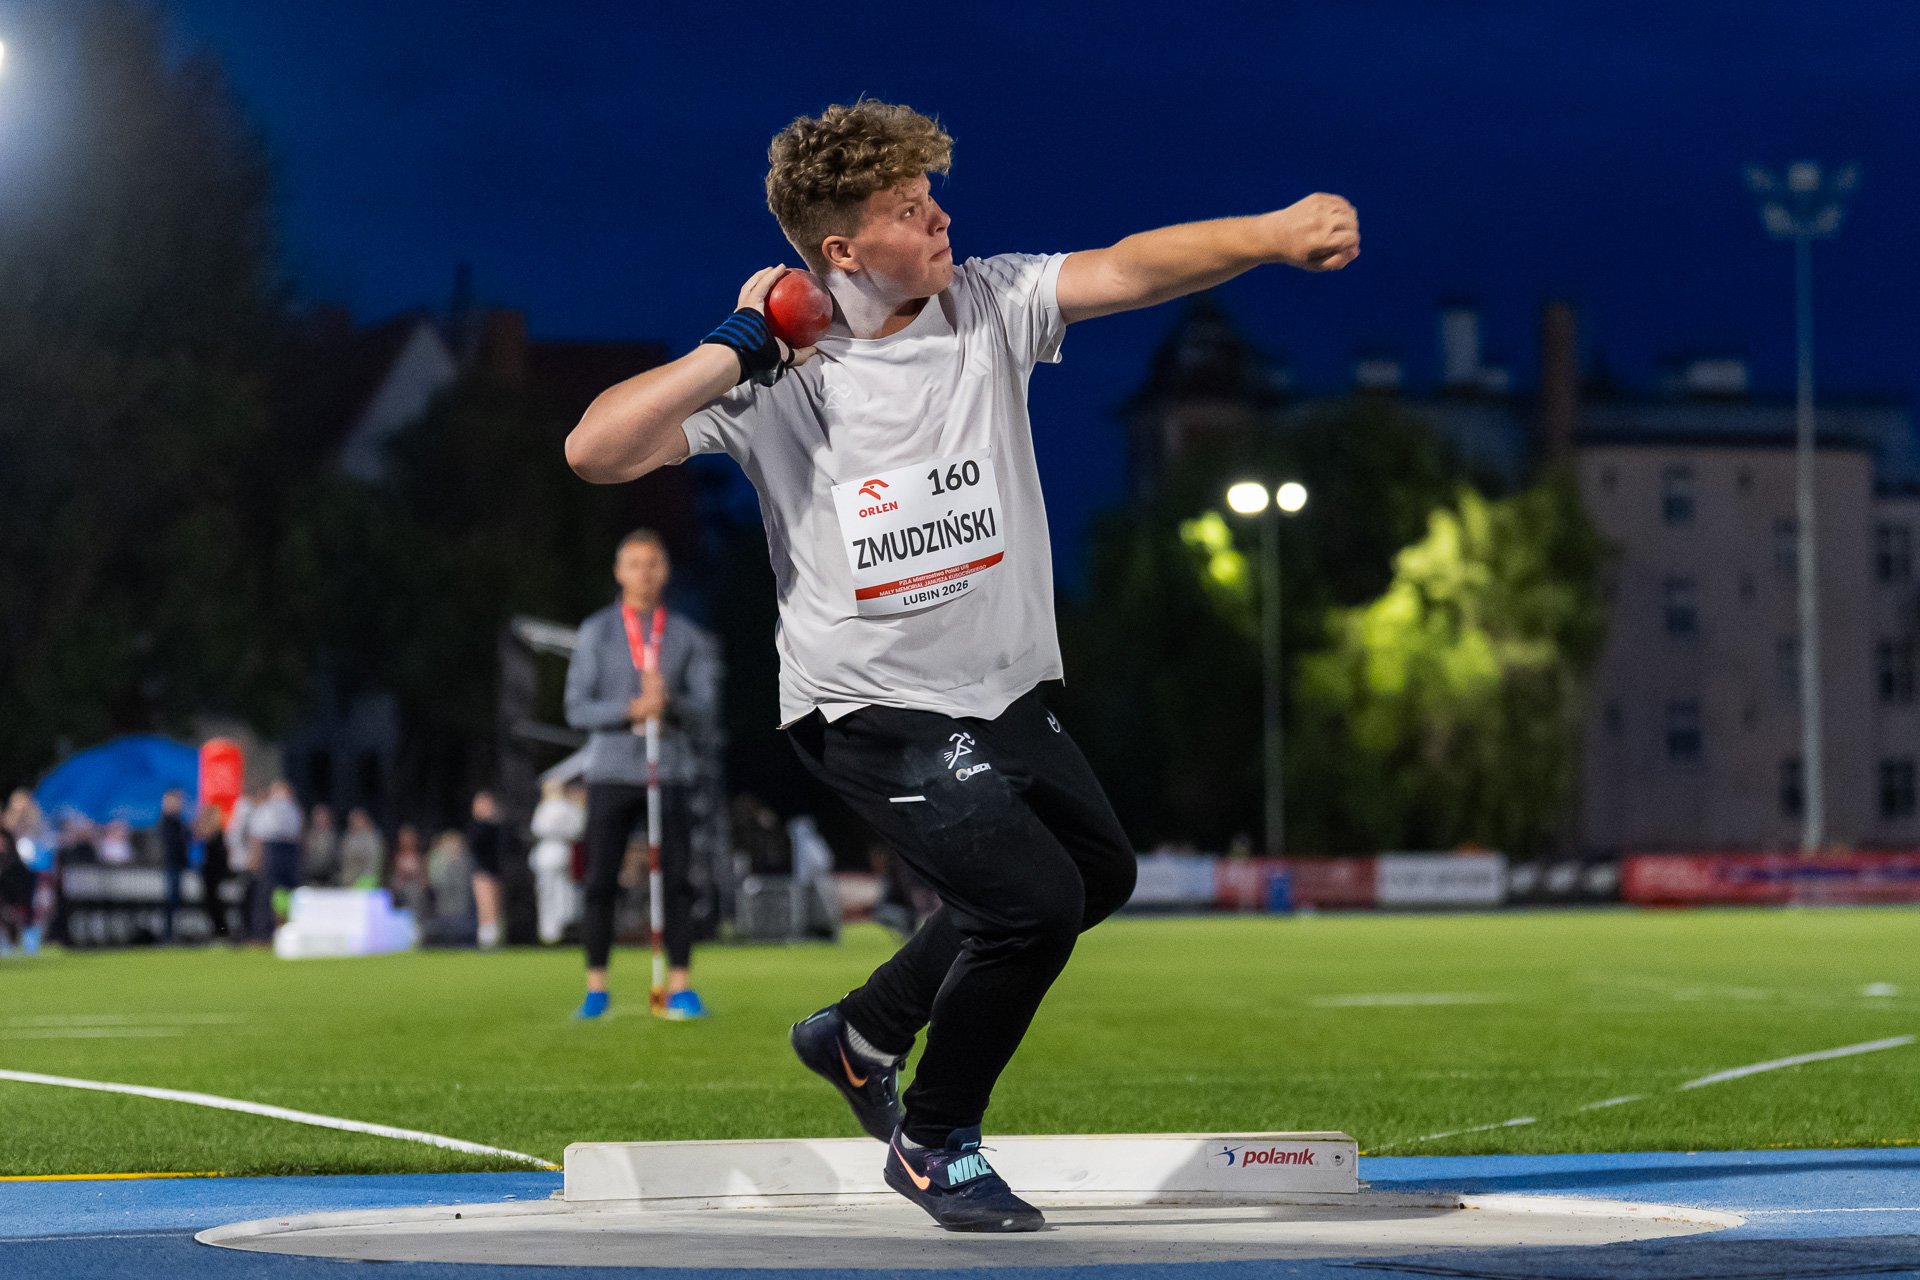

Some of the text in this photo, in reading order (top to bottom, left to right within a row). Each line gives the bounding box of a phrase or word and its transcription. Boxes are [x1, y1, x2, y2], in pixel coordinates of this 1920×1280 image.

[927, 459, 980, 496] 160
[858, 500, 899, 518] ORLEN
[852, 507, 997, 570] ZMUDZIŃSKI
[924, 576, 948, 587] JANUSZA
[945, 566, 960, 575] Polski
[903, 579, 969, 606] LUBIN 2026
[946, 1153, 993, 1186] NIKE
[1242, 1147, 1315, 1168] polanik
